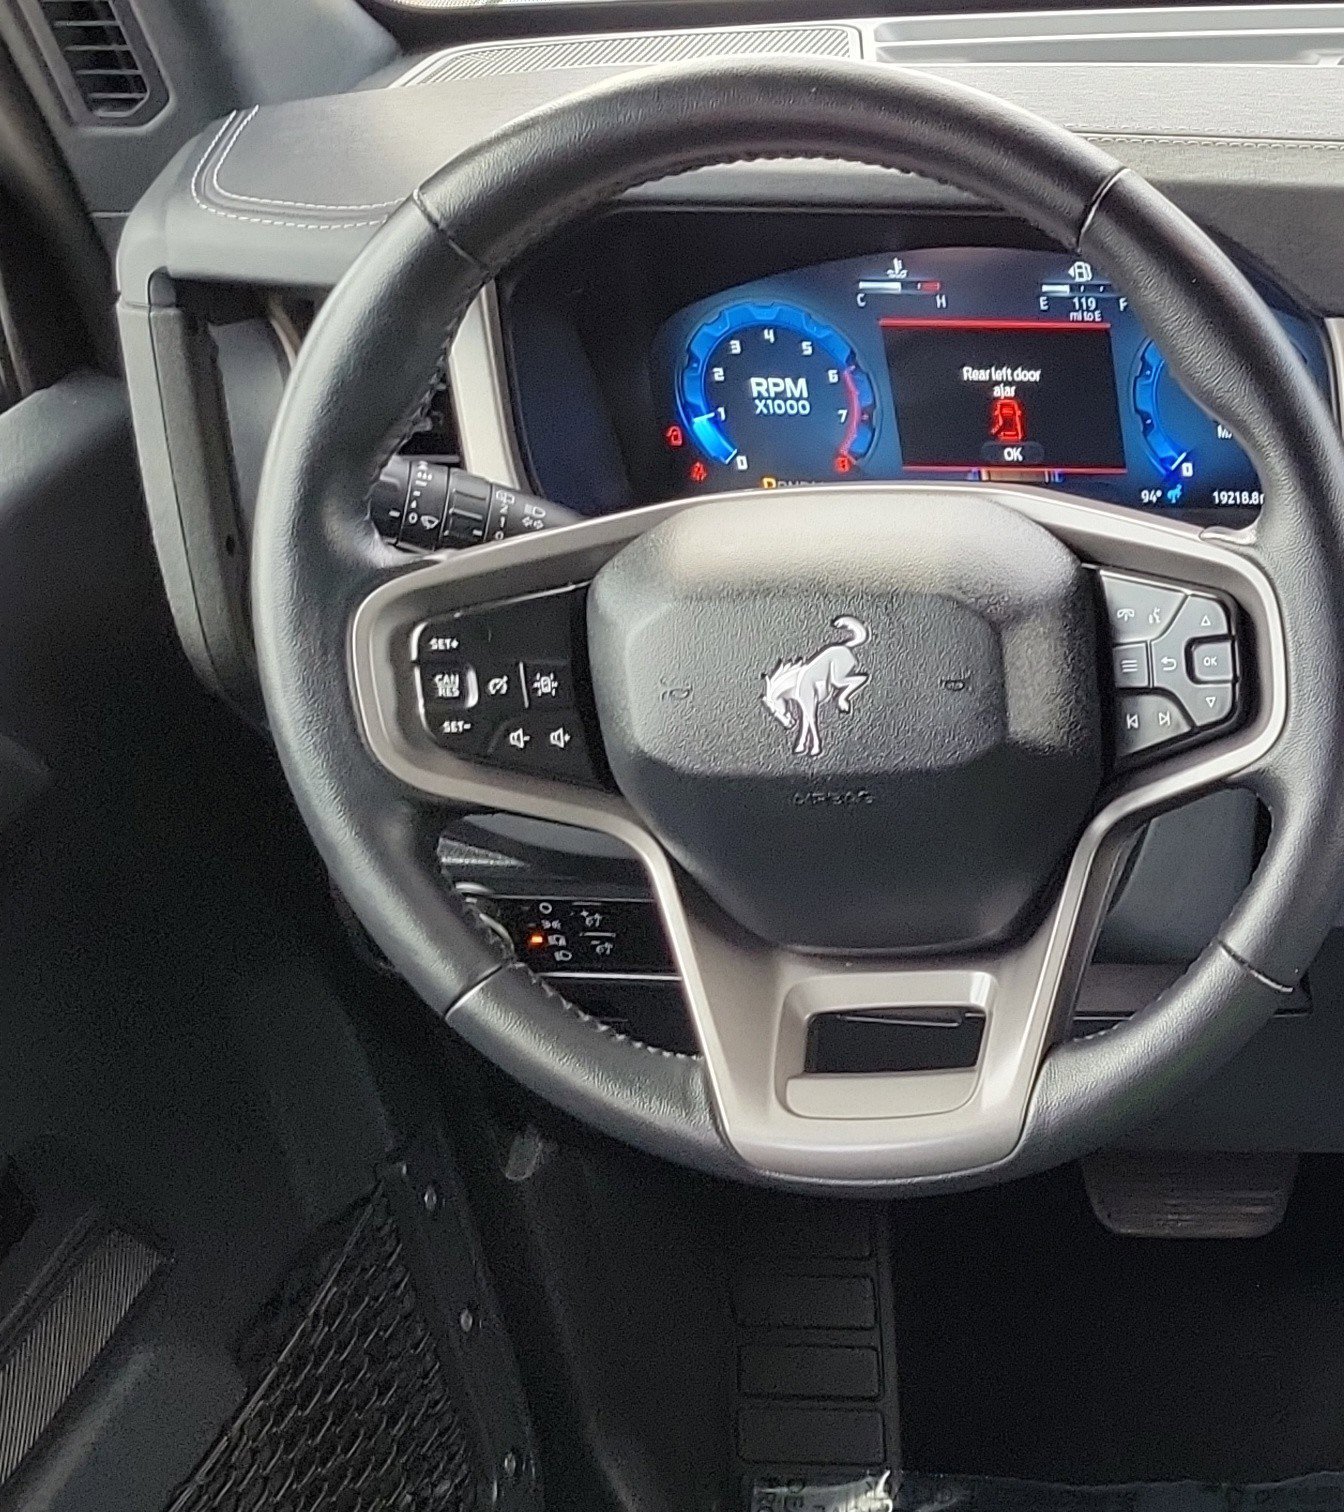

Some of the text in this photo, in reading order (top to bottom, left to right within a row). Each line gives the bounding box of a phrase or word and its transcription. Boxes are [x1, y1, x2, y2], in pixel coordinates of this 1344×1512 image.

[856, 294, 867, 307] C
[936, 295, 947, 308] H
[1040, 297, 1049, 310] E
[1072, 297, 1097, 311] 119
[763, 329, 775, 343] 4
[730, 340, 742, 354] 3
[801, 341, 813, 355] 5
[713, 367, 724, 381] 2
[828, 369, 839, 382] 6
[963, 366, 1041, 382] Rear left door
[750, 377, 809, 398] RPM
[993, 384, 1016, 398] ajar
[718, 407, 726, 420] 1
[754, 399, 811, 416] X1000
[838, 410, 848, 422] 7
[1003, 447, 1023, 461] OK
[736, 456, 748, 470] 0
[1182, 462, 1193, 477] 0
[1203, 656, 1218, 667] OK
